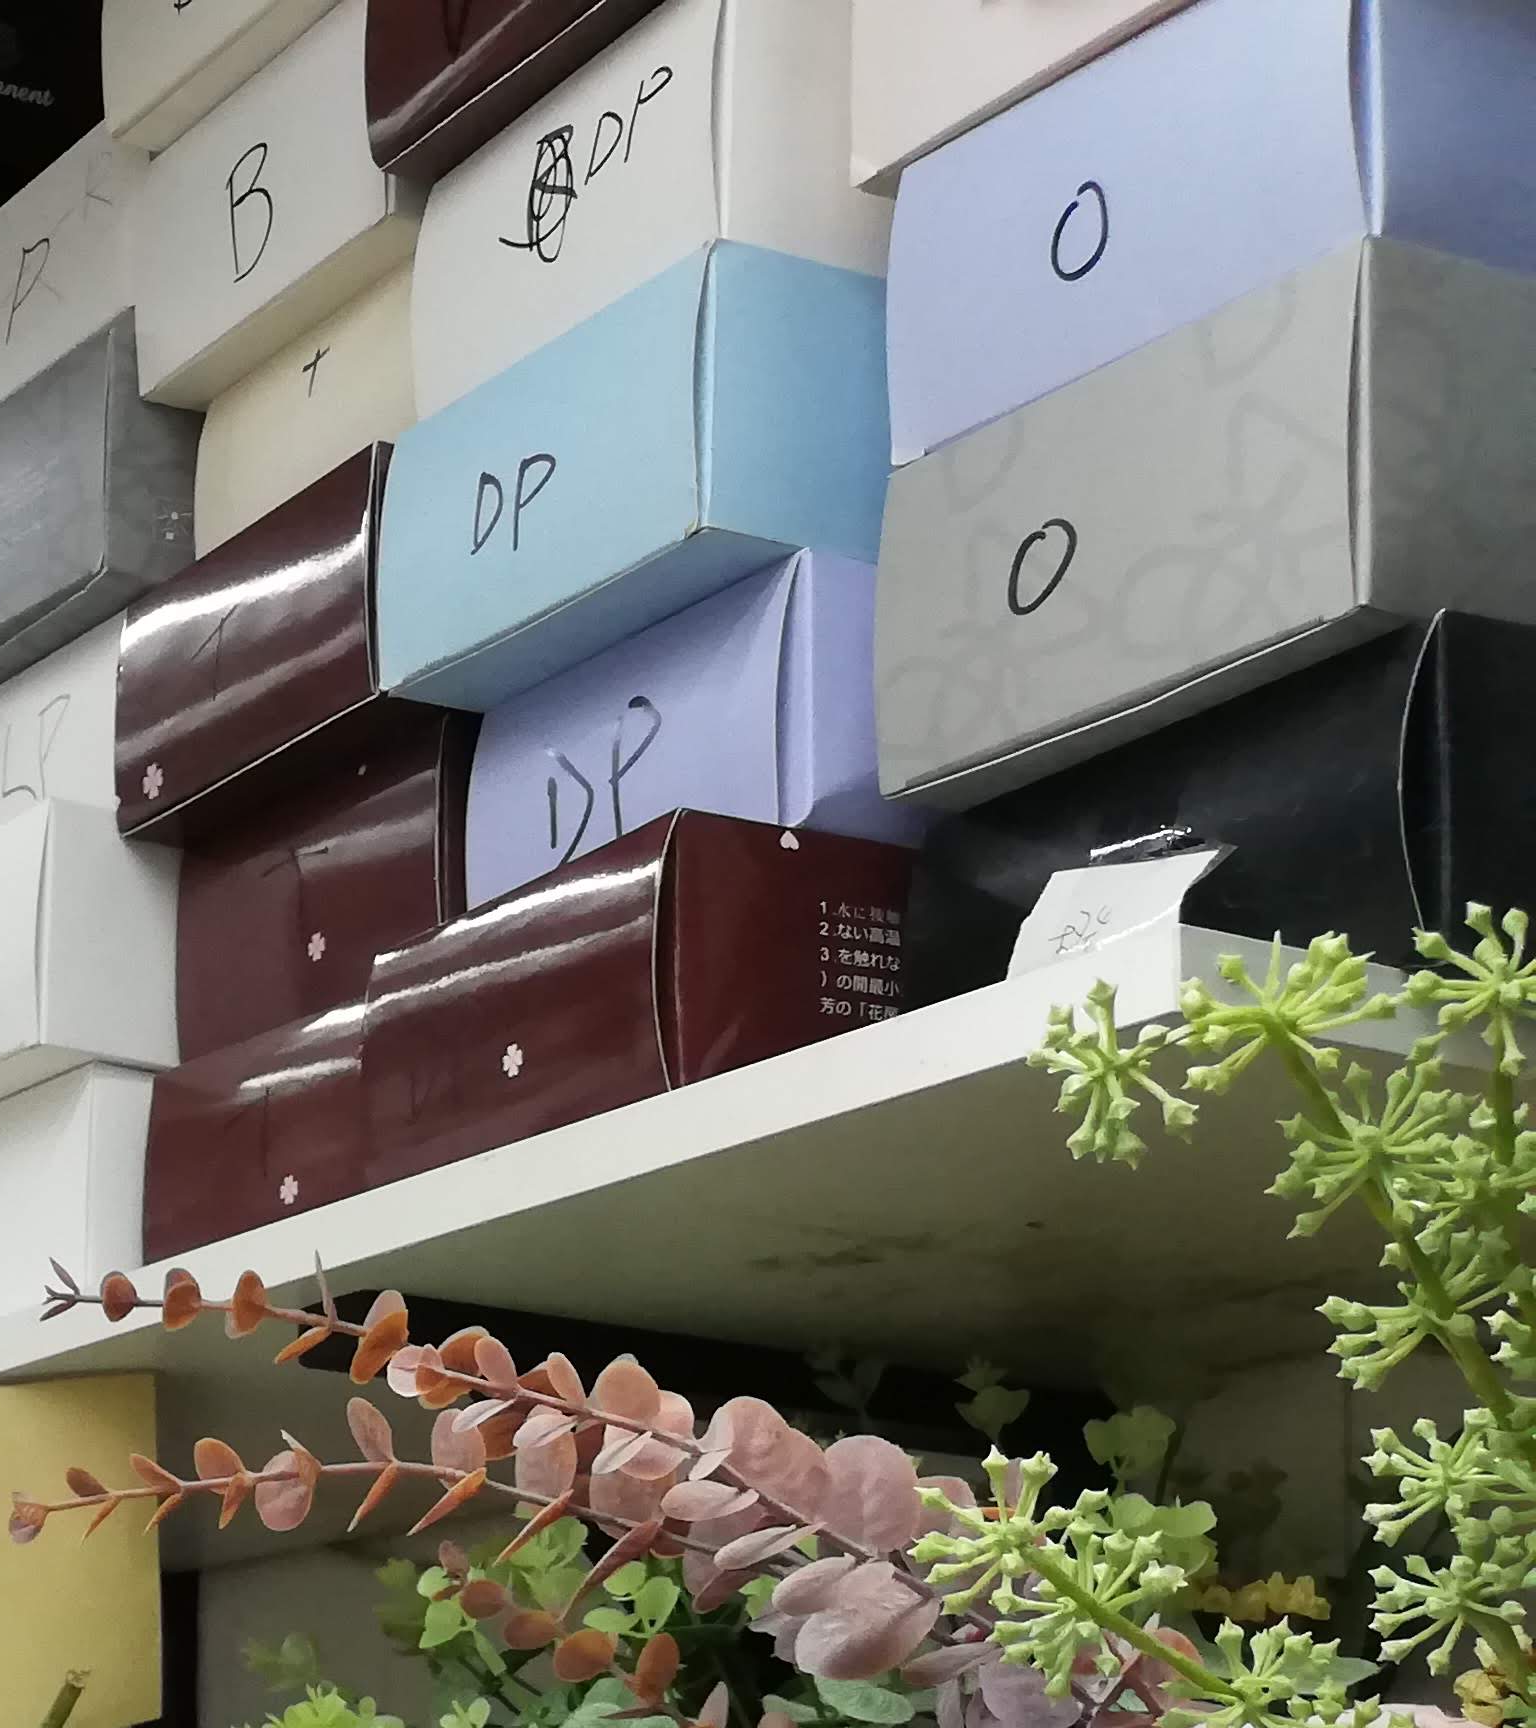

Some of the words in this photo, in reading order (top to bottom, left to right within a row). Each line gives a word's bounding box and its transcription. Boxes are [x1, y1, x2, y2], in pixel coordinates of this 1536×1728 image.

[585, 65, 673, 188] DP
[225, 141, 274, 284] B
[469, 452, 557, 557] DP
[546, 694, 663, 868] DP
